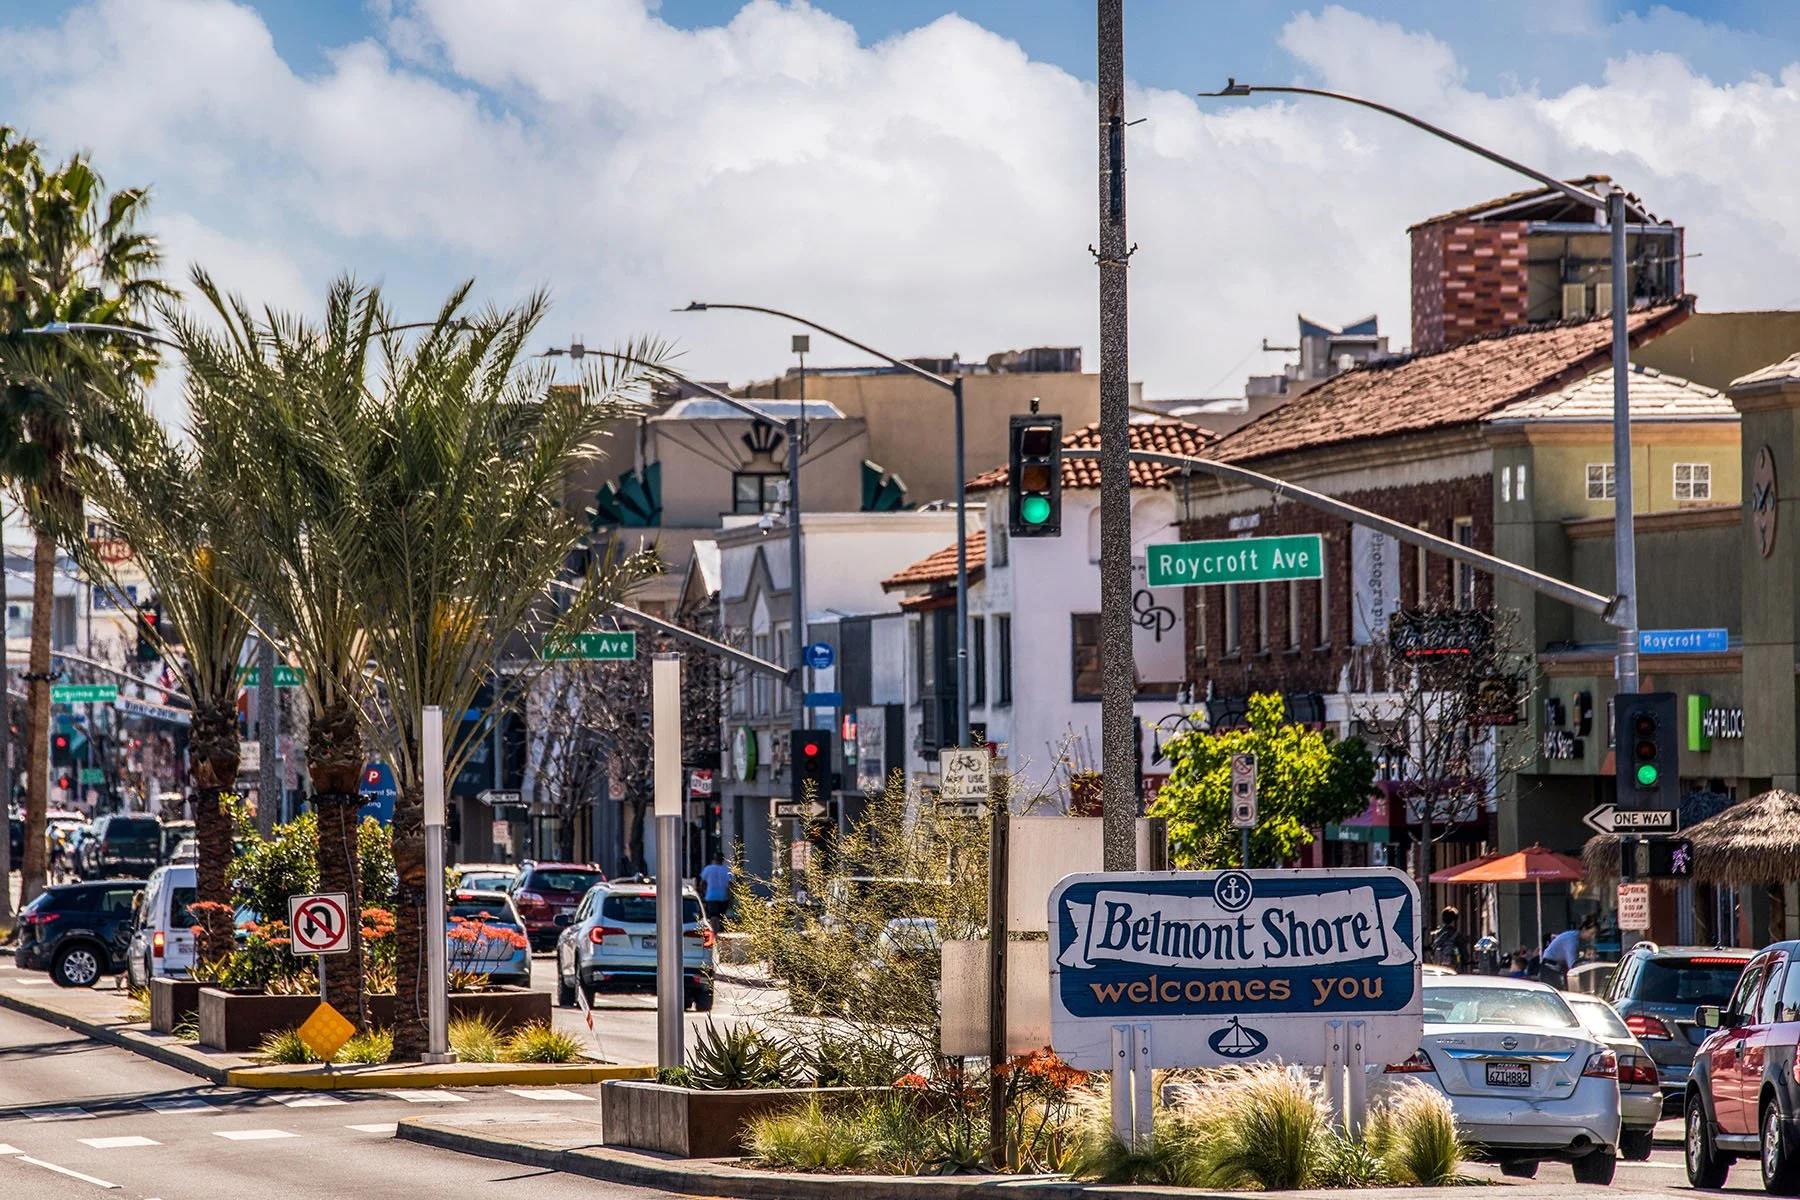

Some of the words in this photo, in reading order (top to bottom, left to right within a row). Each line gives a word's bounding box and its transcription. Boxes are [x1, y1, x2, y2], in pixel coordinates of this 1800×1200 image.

[1160, 550, 1259, 579] Roycroft
[1272, 548, 1309, 570] Ave
[1369, 532, 1386, 645] Photograph
[600, 640, 629, 652] Ave
[1643, 634, 1701, 650] Roycroft
[968, 775, 984, 783] USE
[967, 785, 988, 795] LANE
[1614, 813, 1639, 825] ONE
[1642, 813, 1668, 825] WAY
[1097, 900, 1255, 961] Belmont
[1262, 907, 1372, 960] Shore
[1090, 974, 1291, 1004] welcomes
[1312, 976, 1384, 1006] you
